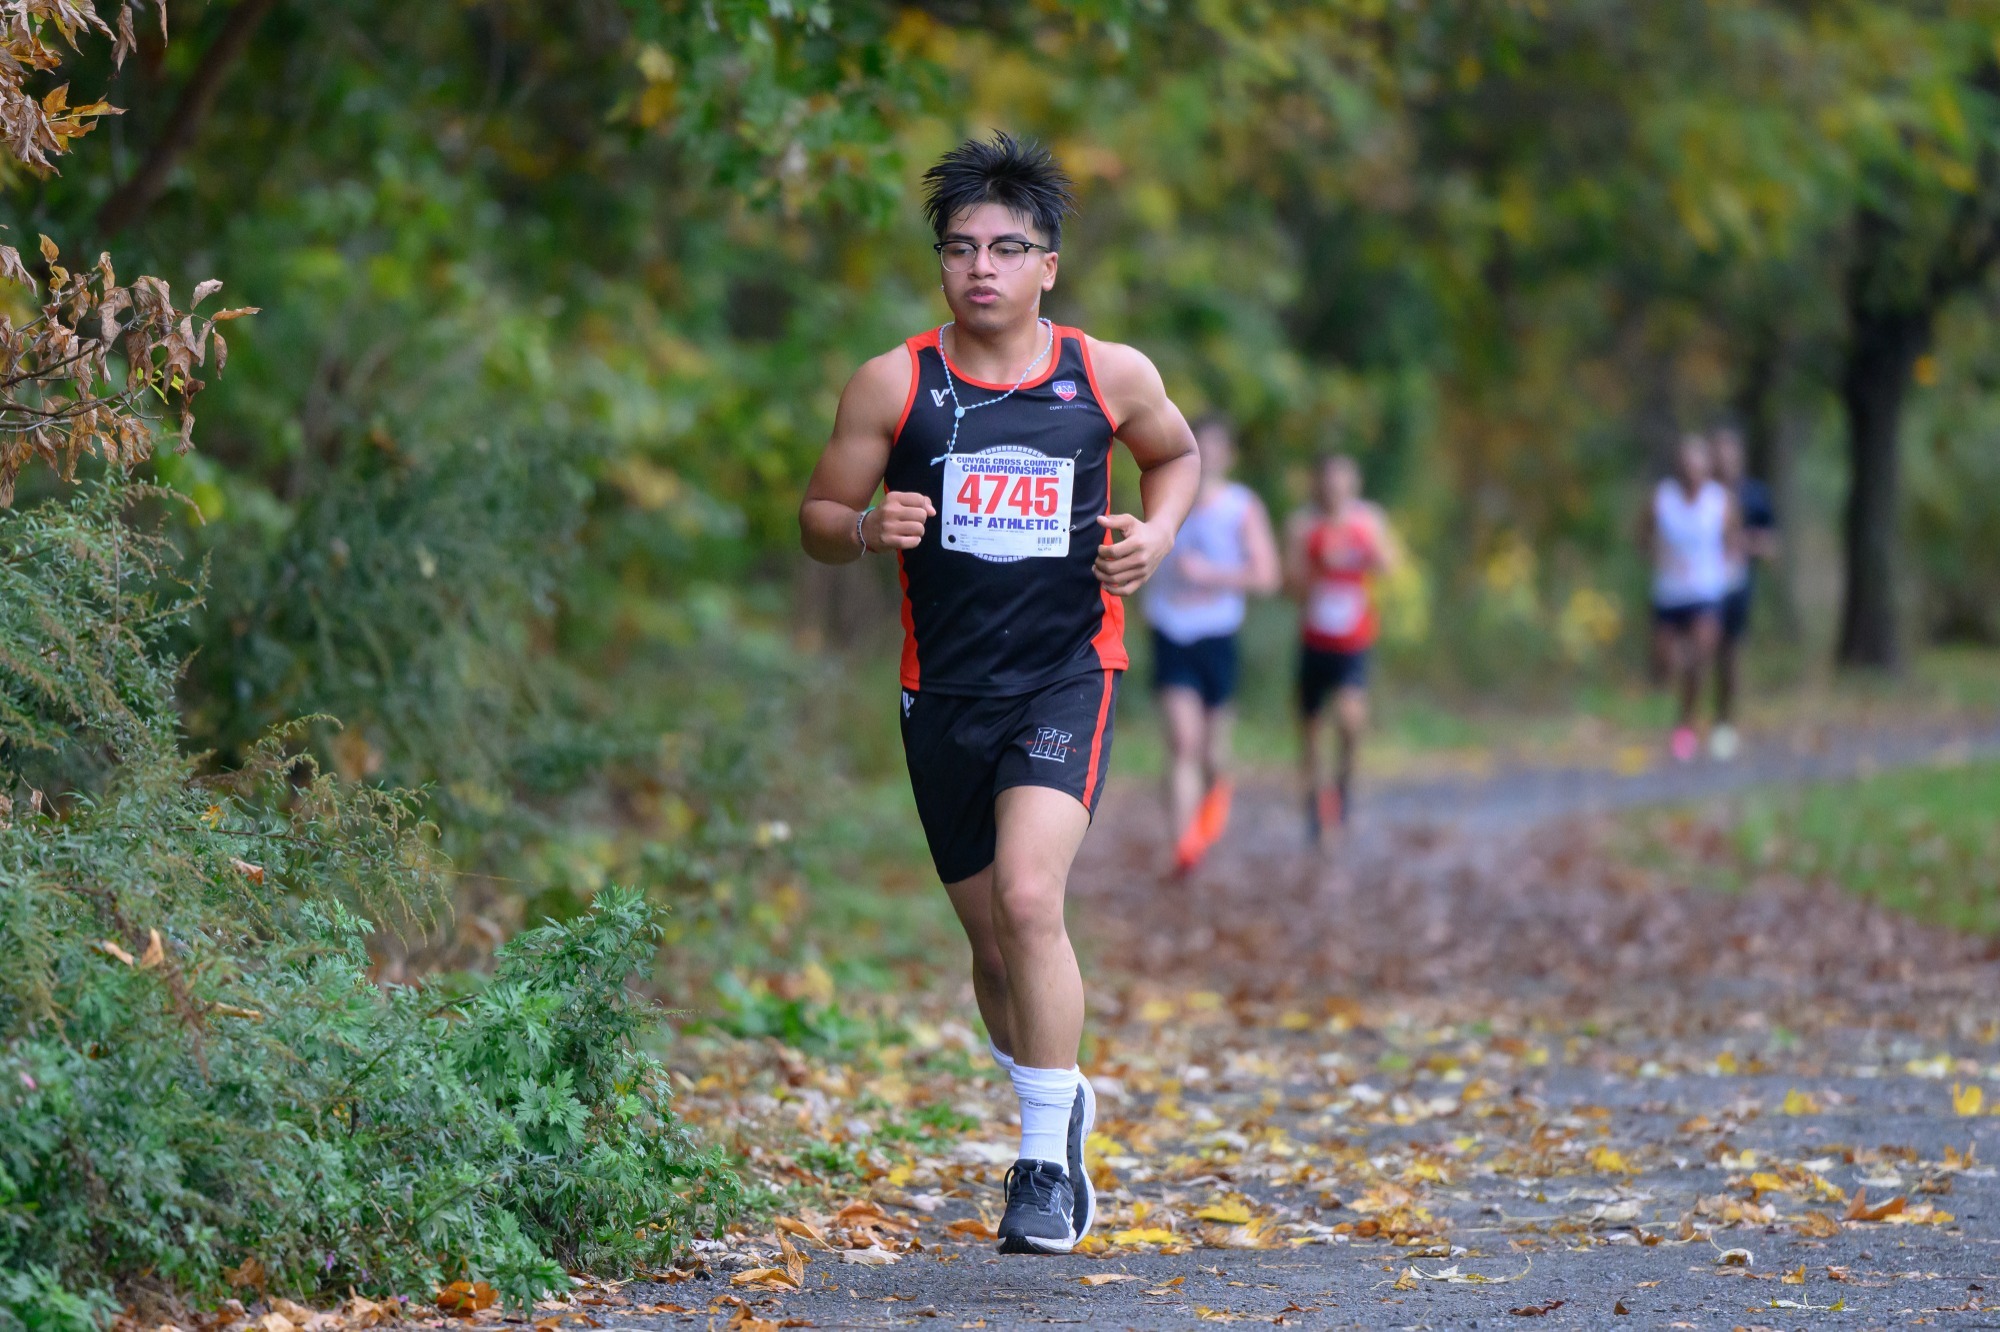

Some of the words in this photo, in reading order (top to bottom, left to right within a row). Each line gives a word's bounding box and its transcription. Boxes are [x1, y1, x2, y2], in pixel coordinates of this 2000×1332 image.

[956, 456, 990, 465] CUNYAC
[992, 458, 1024, 466] CROSS
[1025, 459, 1063, 468] COUNTRY
[962, 463, 1057, 476] CHAMPIONSHIPS
[956, 474, 1059, 517] 4745
[953, 514, 983, 527] M-F
[987, 517, 1059, 531] ATHLETIC
